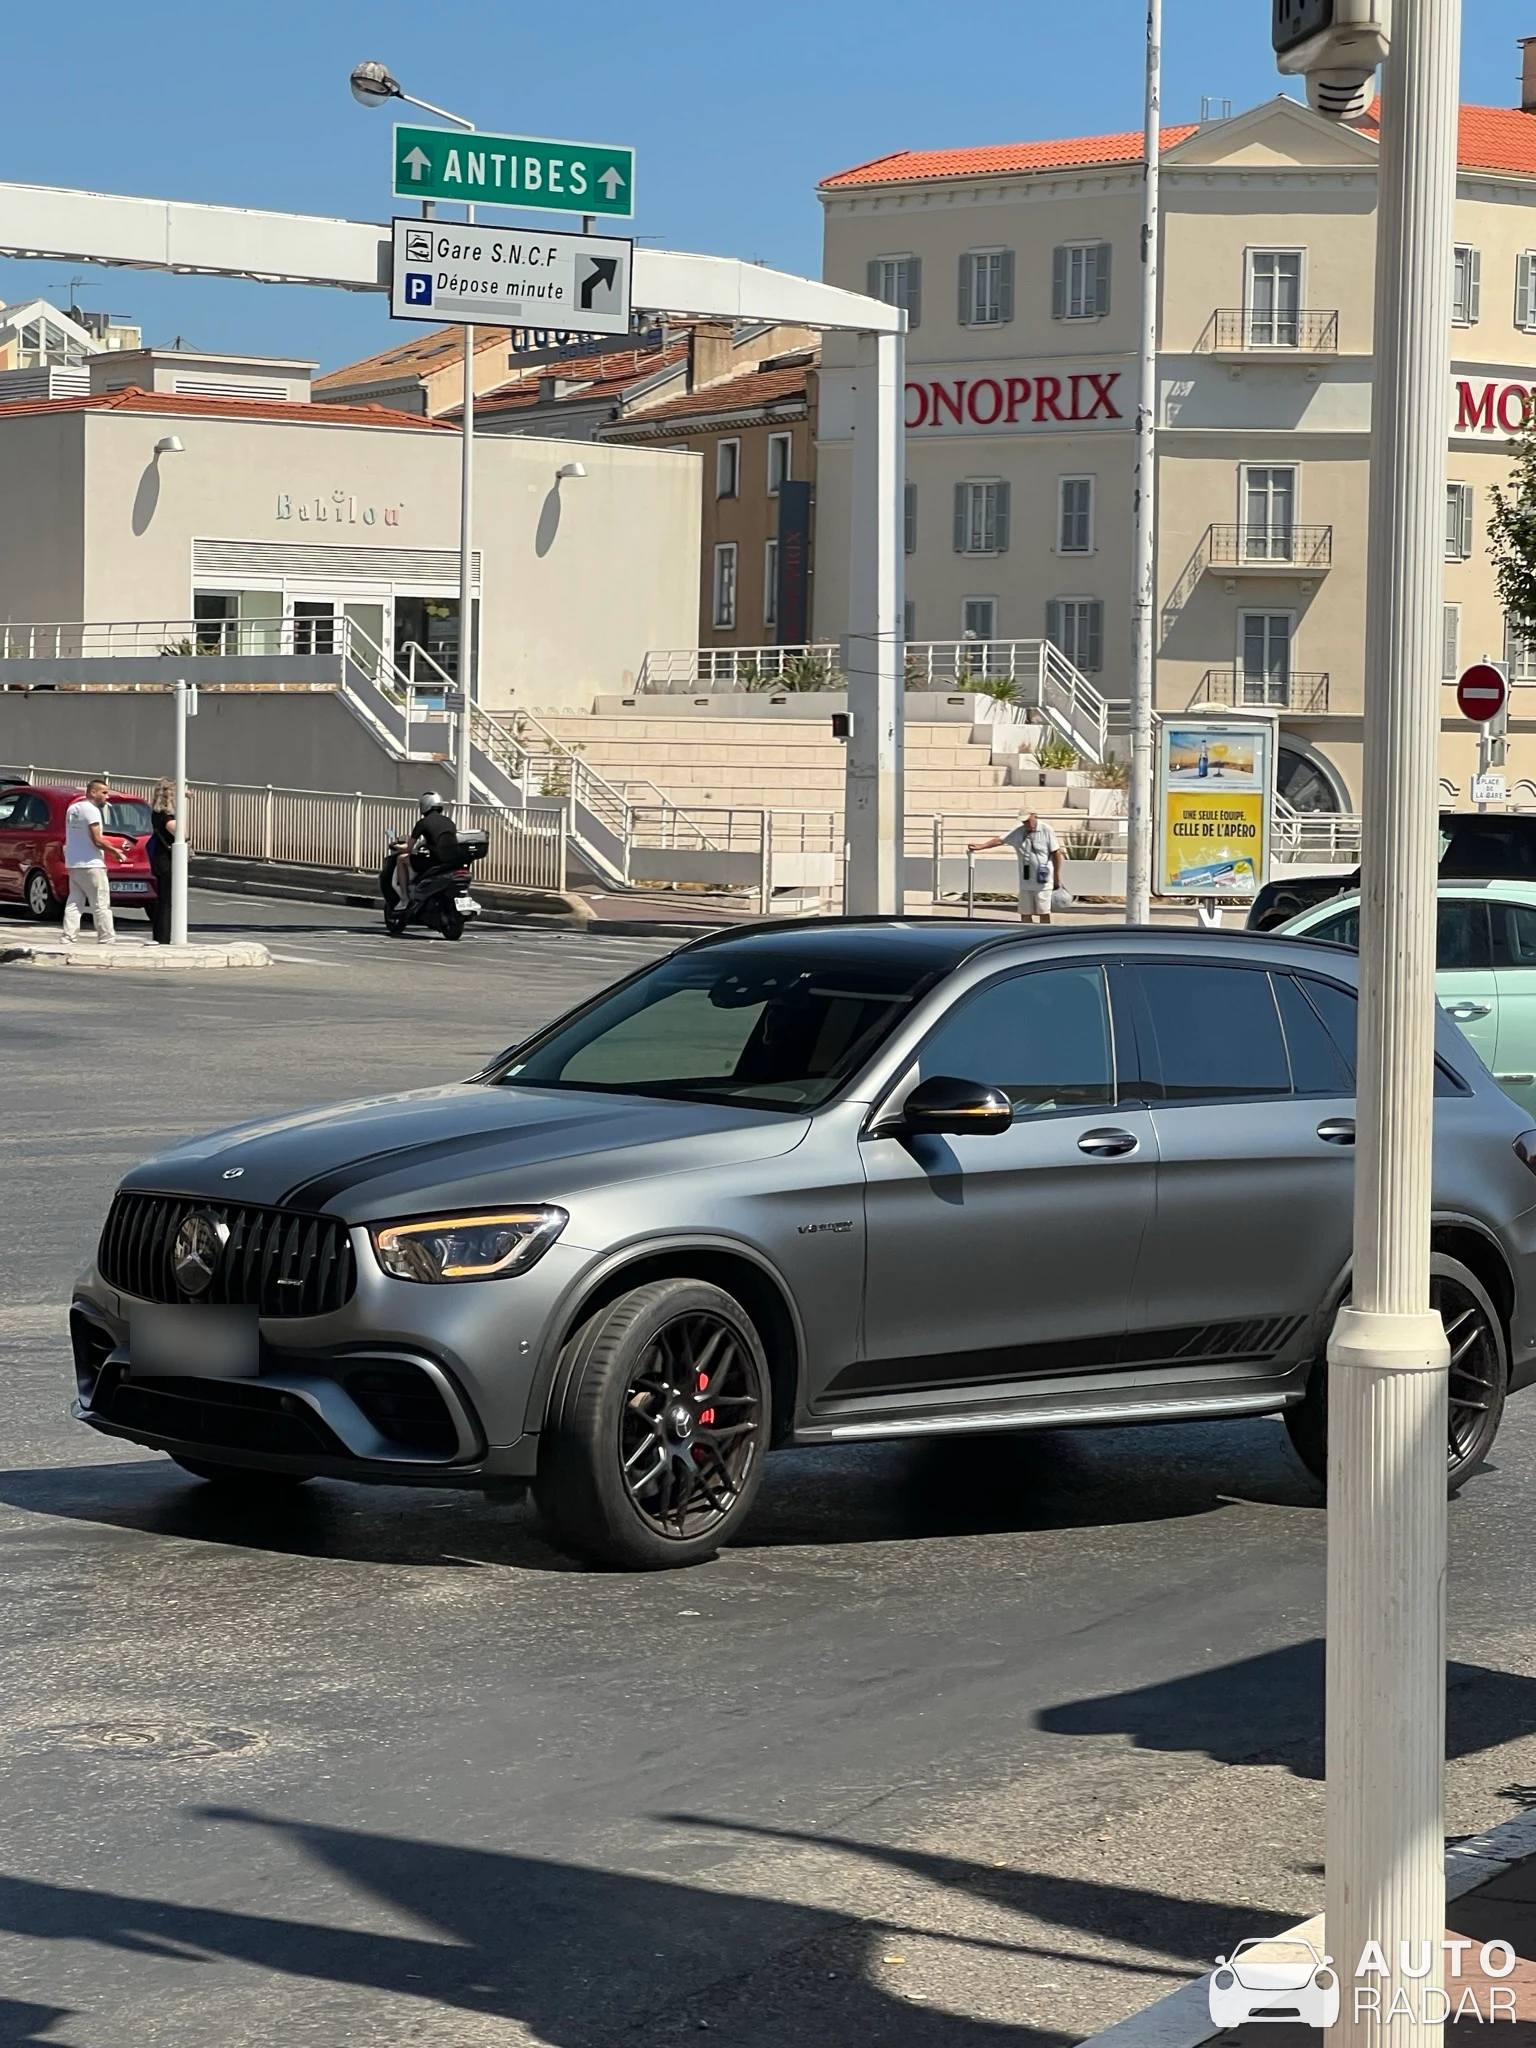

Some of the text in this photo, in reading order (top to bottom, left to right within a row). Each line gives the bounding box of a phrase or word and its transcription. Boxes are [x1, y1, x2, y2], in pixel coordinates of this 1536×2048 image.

[443, 150, 588, 195] ANTIBES
[437, 238, 557, 267] Gare S.N.C.F
[411, 279, 426, 299] P
[436, 272, 563, 299] Dépose minute
[905, 373, 1123, 428] ONOPRIX
[1454, 382, 1536, 433] MO
[276, 490, 400, 526] Babilou
[1183, 810, 1196, 819] UNE
[1199, 811, 1218, 820] SEULE
[1173, 823, 1256, 837] CELLE DE L'APÉRO
